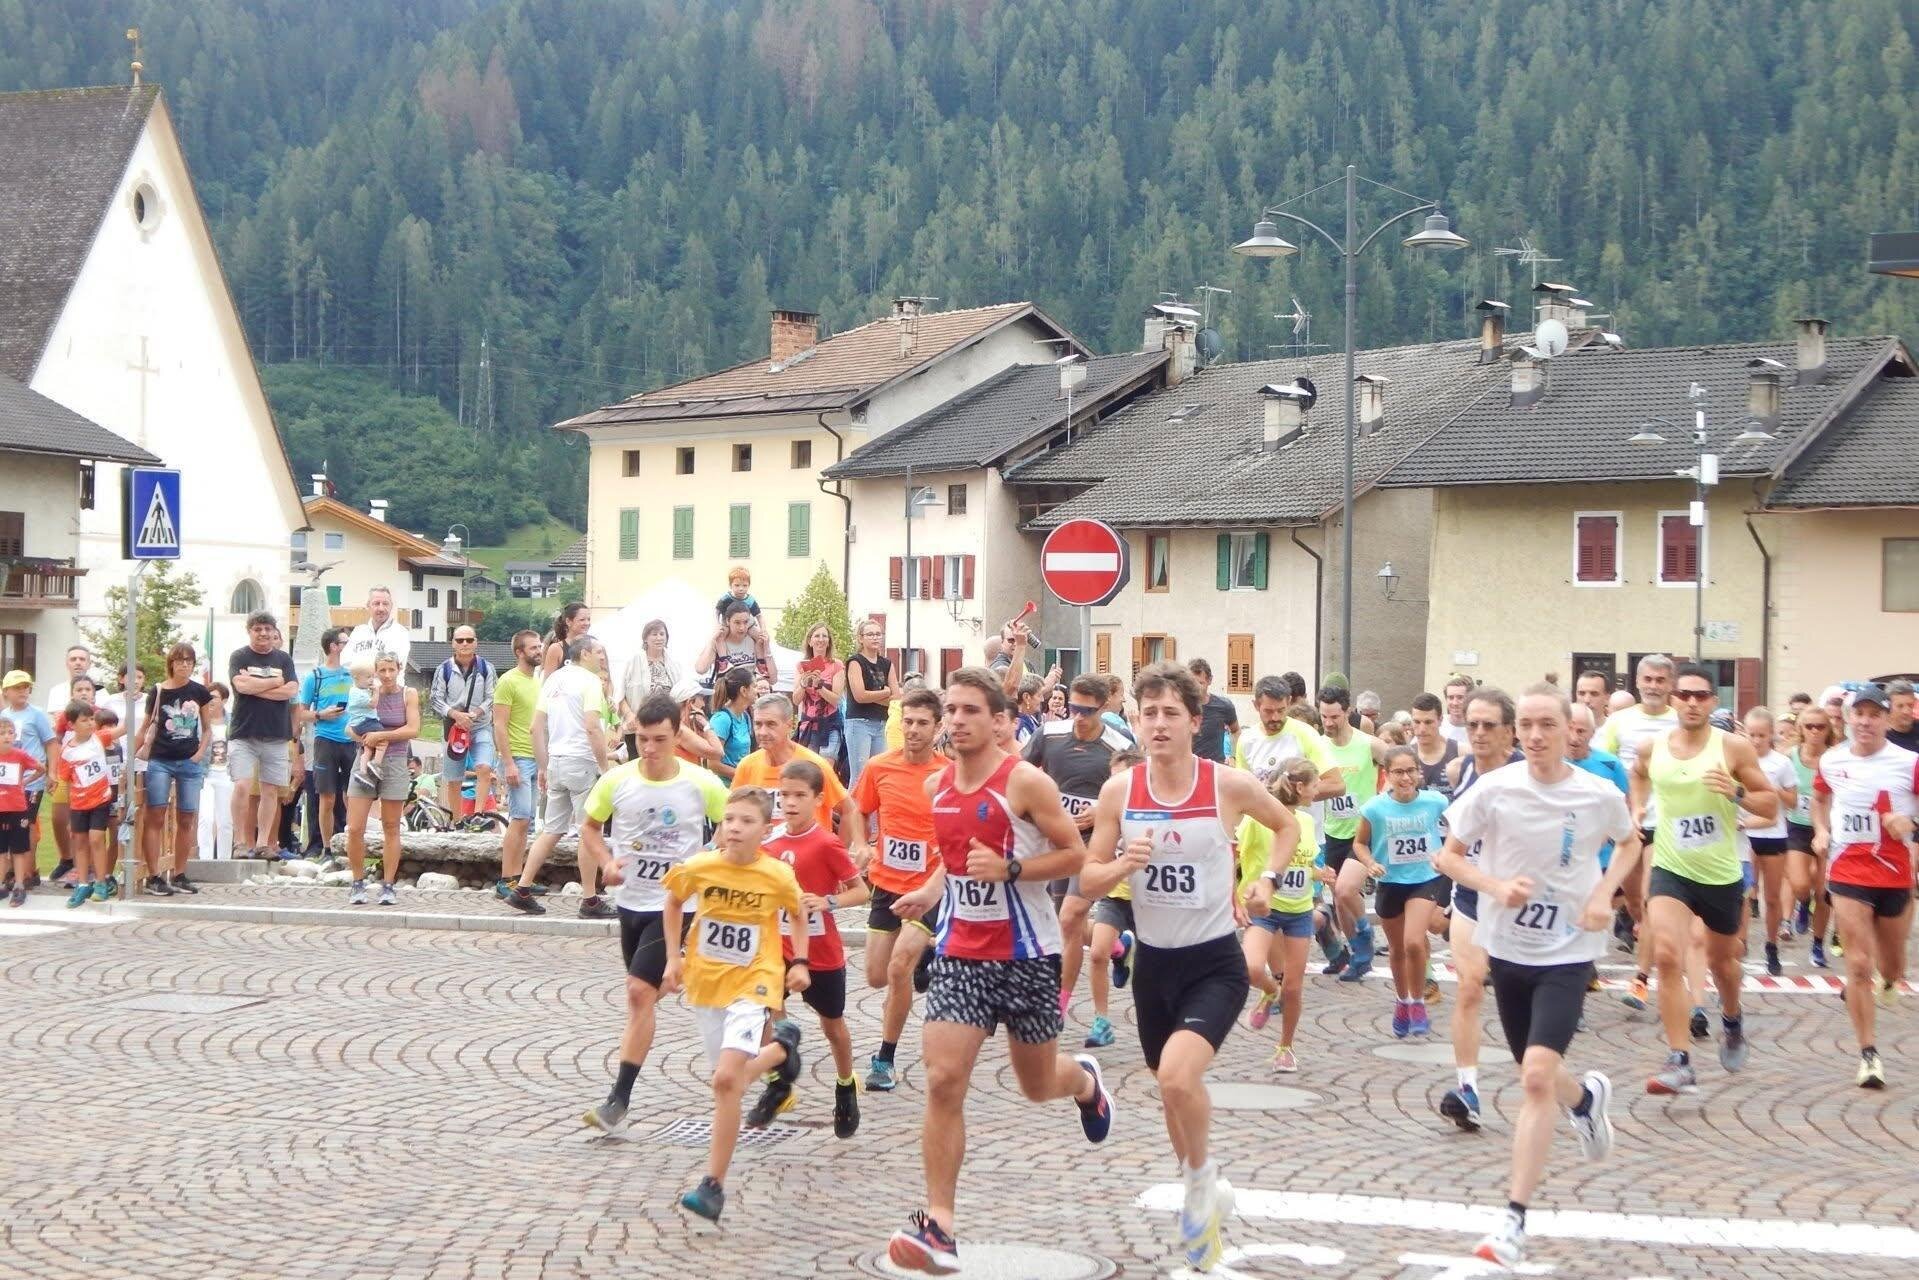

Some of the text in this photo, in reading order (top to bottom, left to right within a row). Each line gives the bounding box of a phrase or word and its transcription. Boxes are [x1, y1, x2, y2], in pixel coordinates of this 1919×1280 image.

[84, 761, 101, 777] 28
[1680, 816, 1714, 838] 246
[1843, 814, 1872, 832] 201
[889, 839, 920, 861] 236
[1395, 837, 1427, 855] 234
[1144, 864, 1195, 893] 263
[955, 880, 997, 906] 262
[1514, 903, 1559, 930] 227
[707, 921, 751, 952] 268
